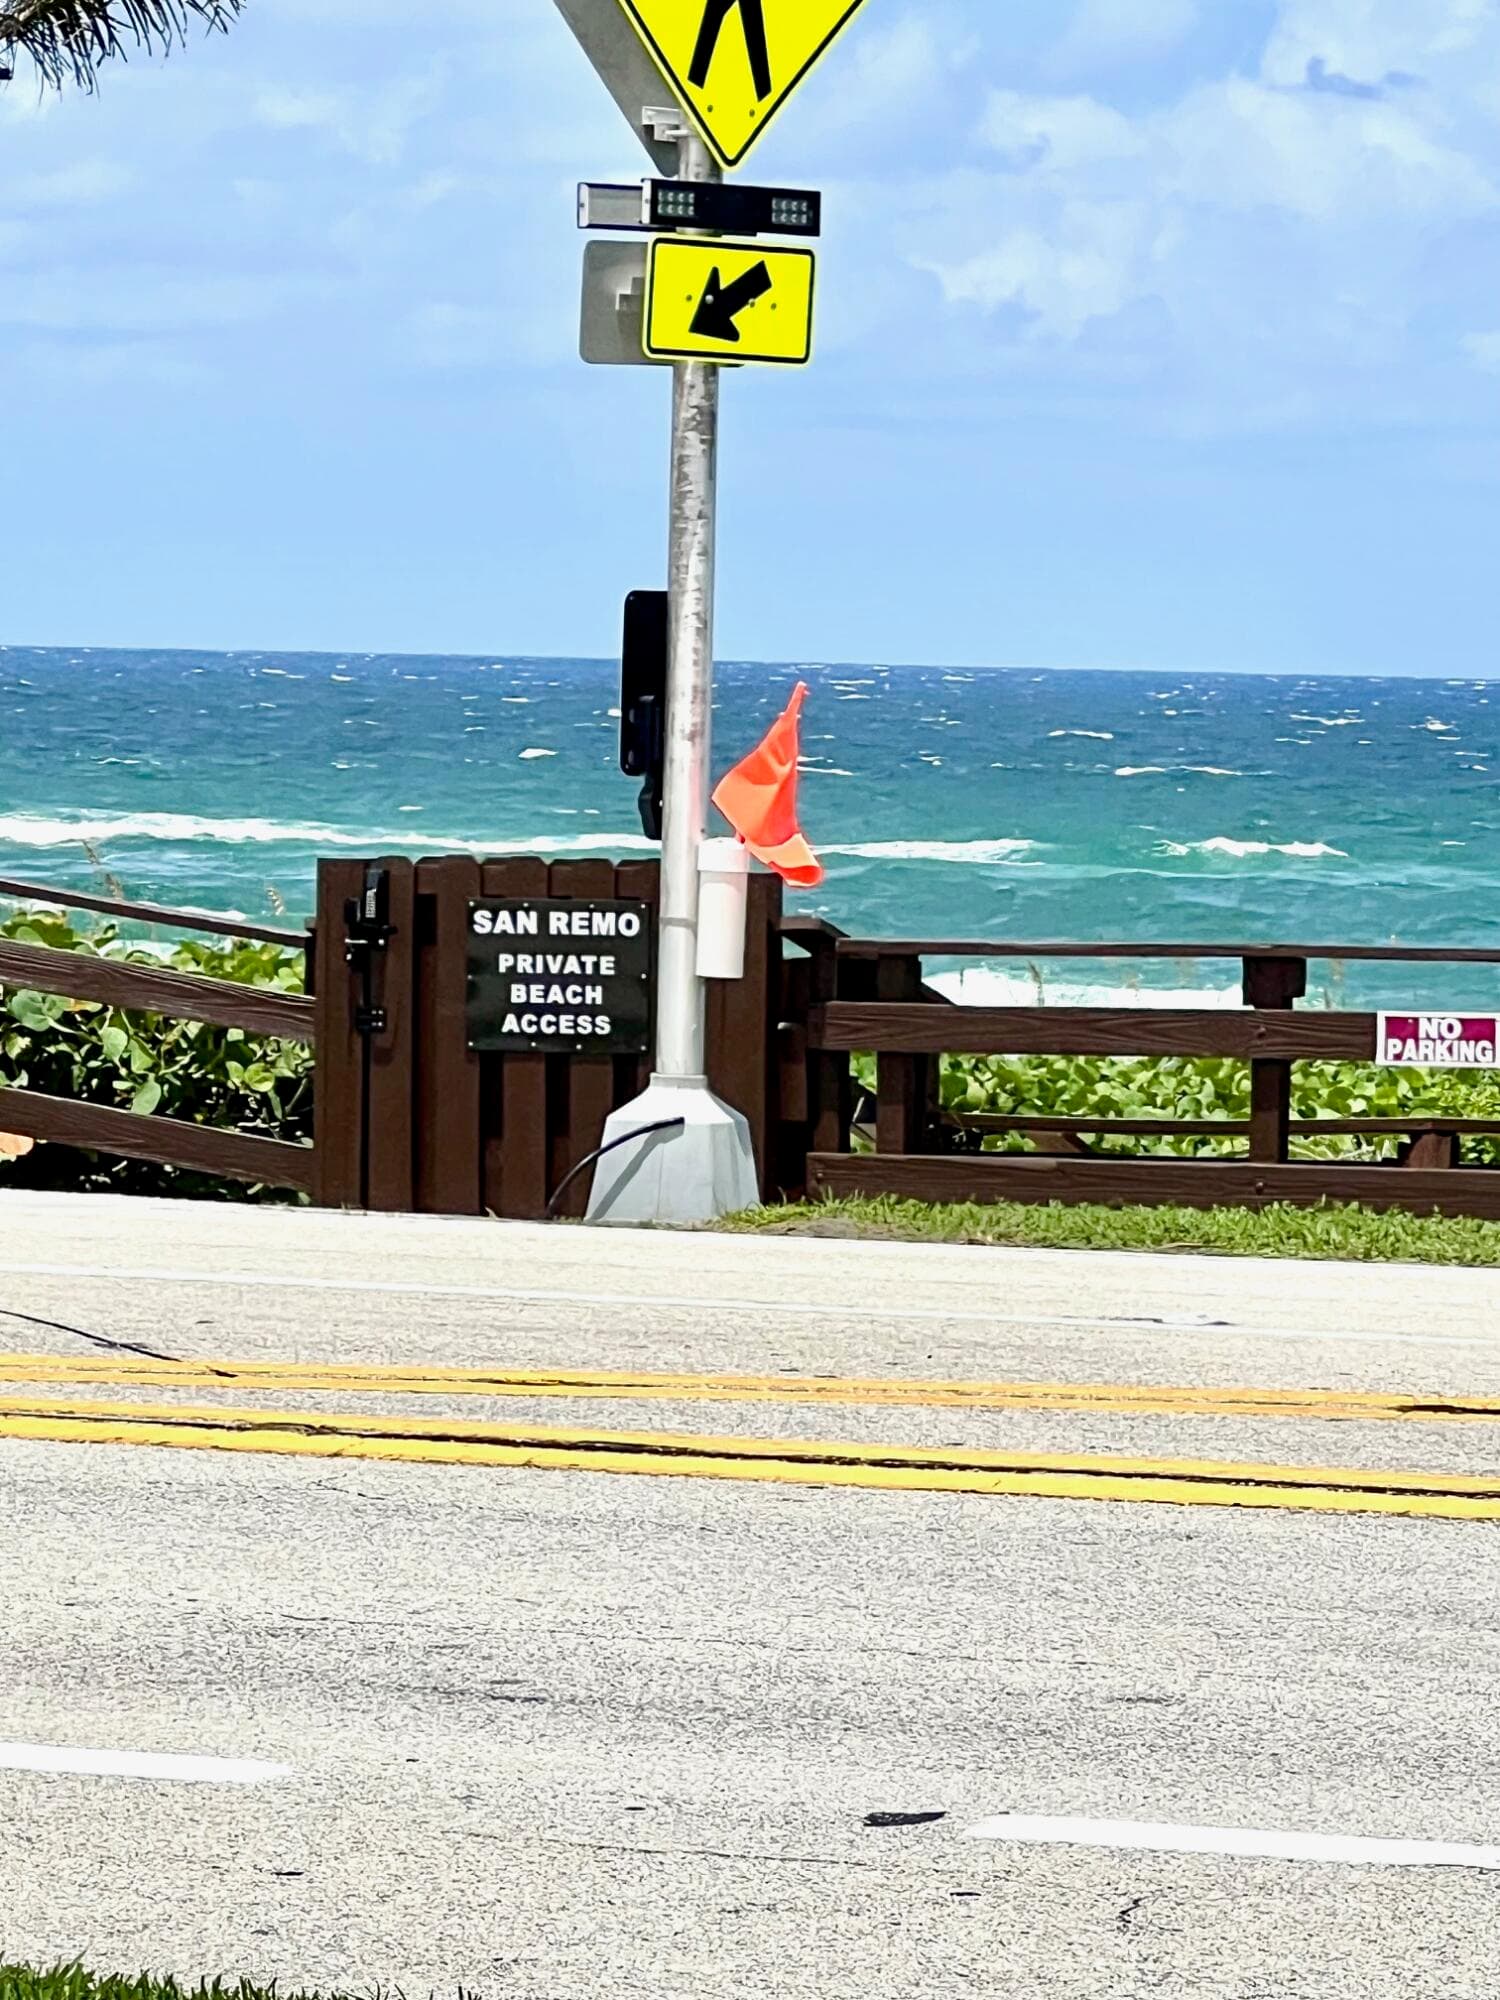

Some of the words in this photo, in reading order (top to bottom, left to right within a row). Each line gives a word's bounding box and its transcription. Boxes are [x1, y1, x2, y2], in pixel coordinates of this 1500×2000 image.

[473, 910, 538, 935] SAN
[549, 912, 641, 937] REMO
[498, 953, 616, 975] PRIVATE
[510, 984, 603, 1005] BEACH
[501, 1013, 612, 1035] ACCESS
[1418, 1017, 1463, 1040] NO
[1386, 1038, 1494, 1063] PARKING
